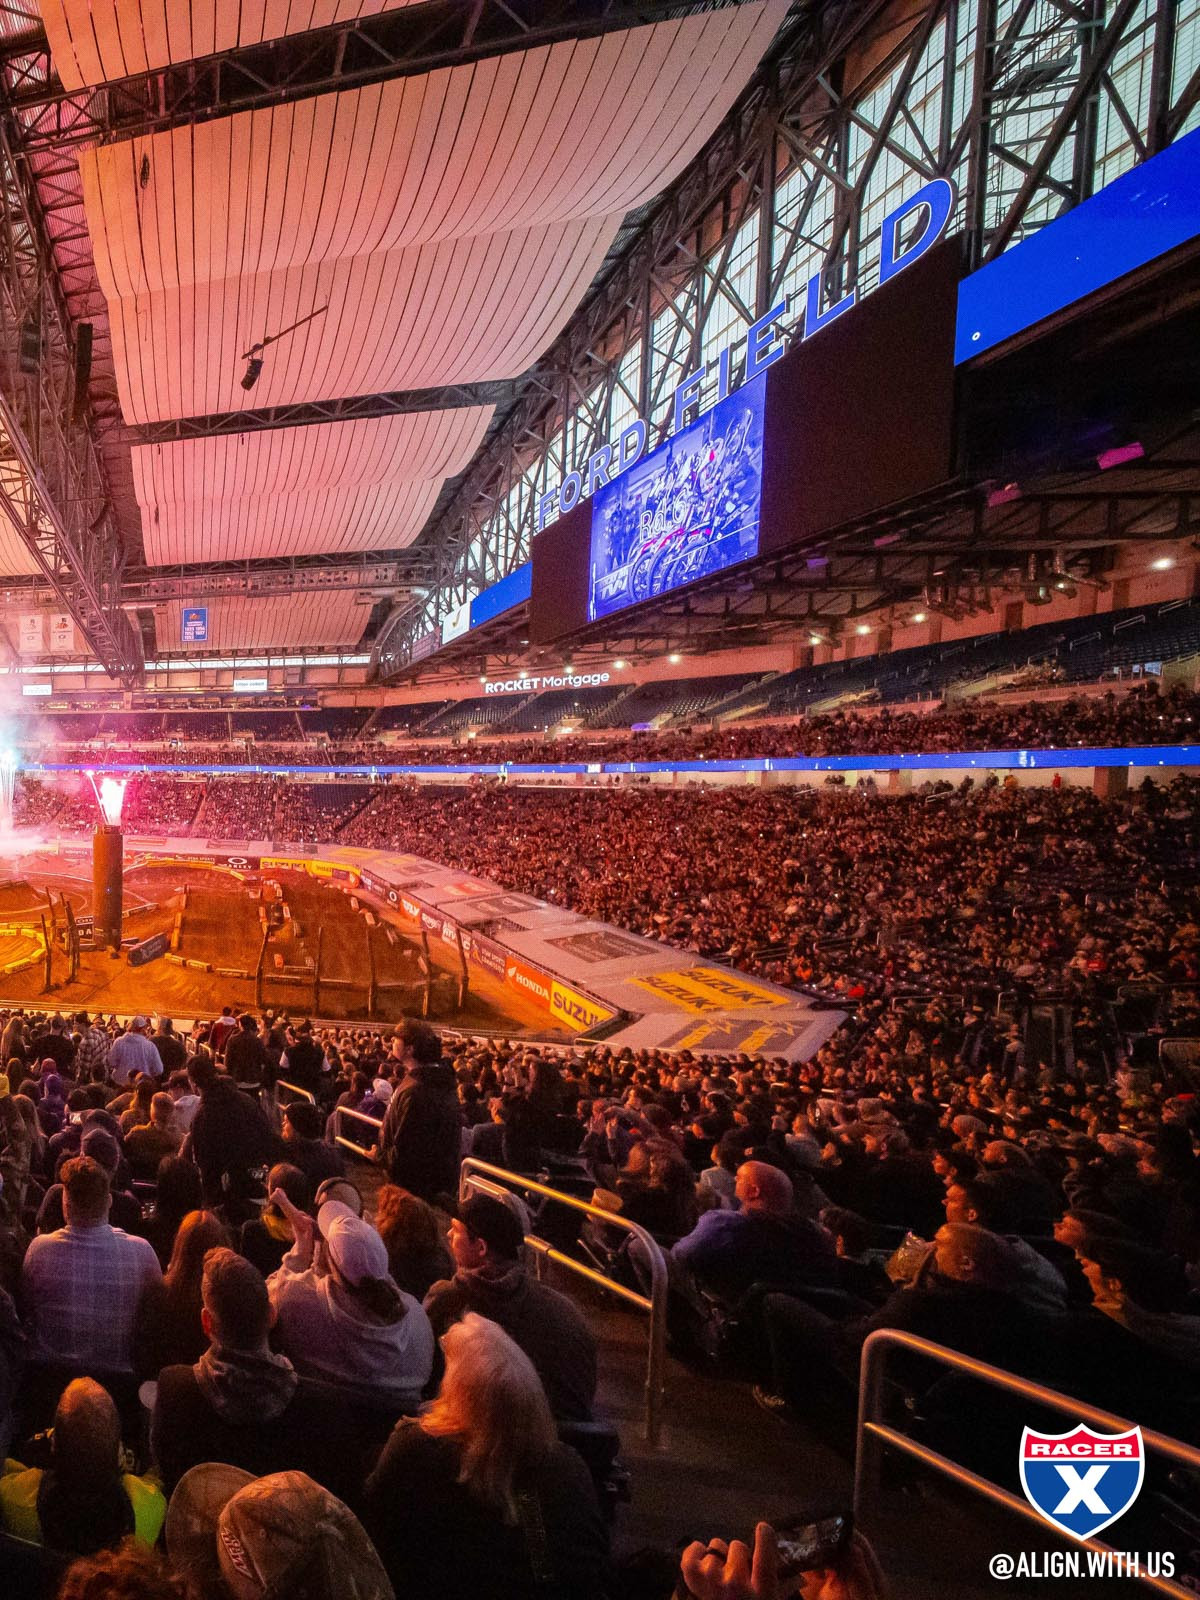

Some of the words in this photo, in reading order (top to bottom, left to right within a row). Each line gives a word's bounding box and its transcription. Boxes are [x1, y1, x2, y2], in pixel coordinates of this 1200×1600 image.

[538, 418, 647, 532] FORD
[674, 176, 956, 431] FIELD
[485, 677, 541, 694] ROCKET
[542, 672, 610, 689] Mortgage
[515, 972, 550, 1001] HONDA
[678, 969, 774, 1006] SUZUKI
